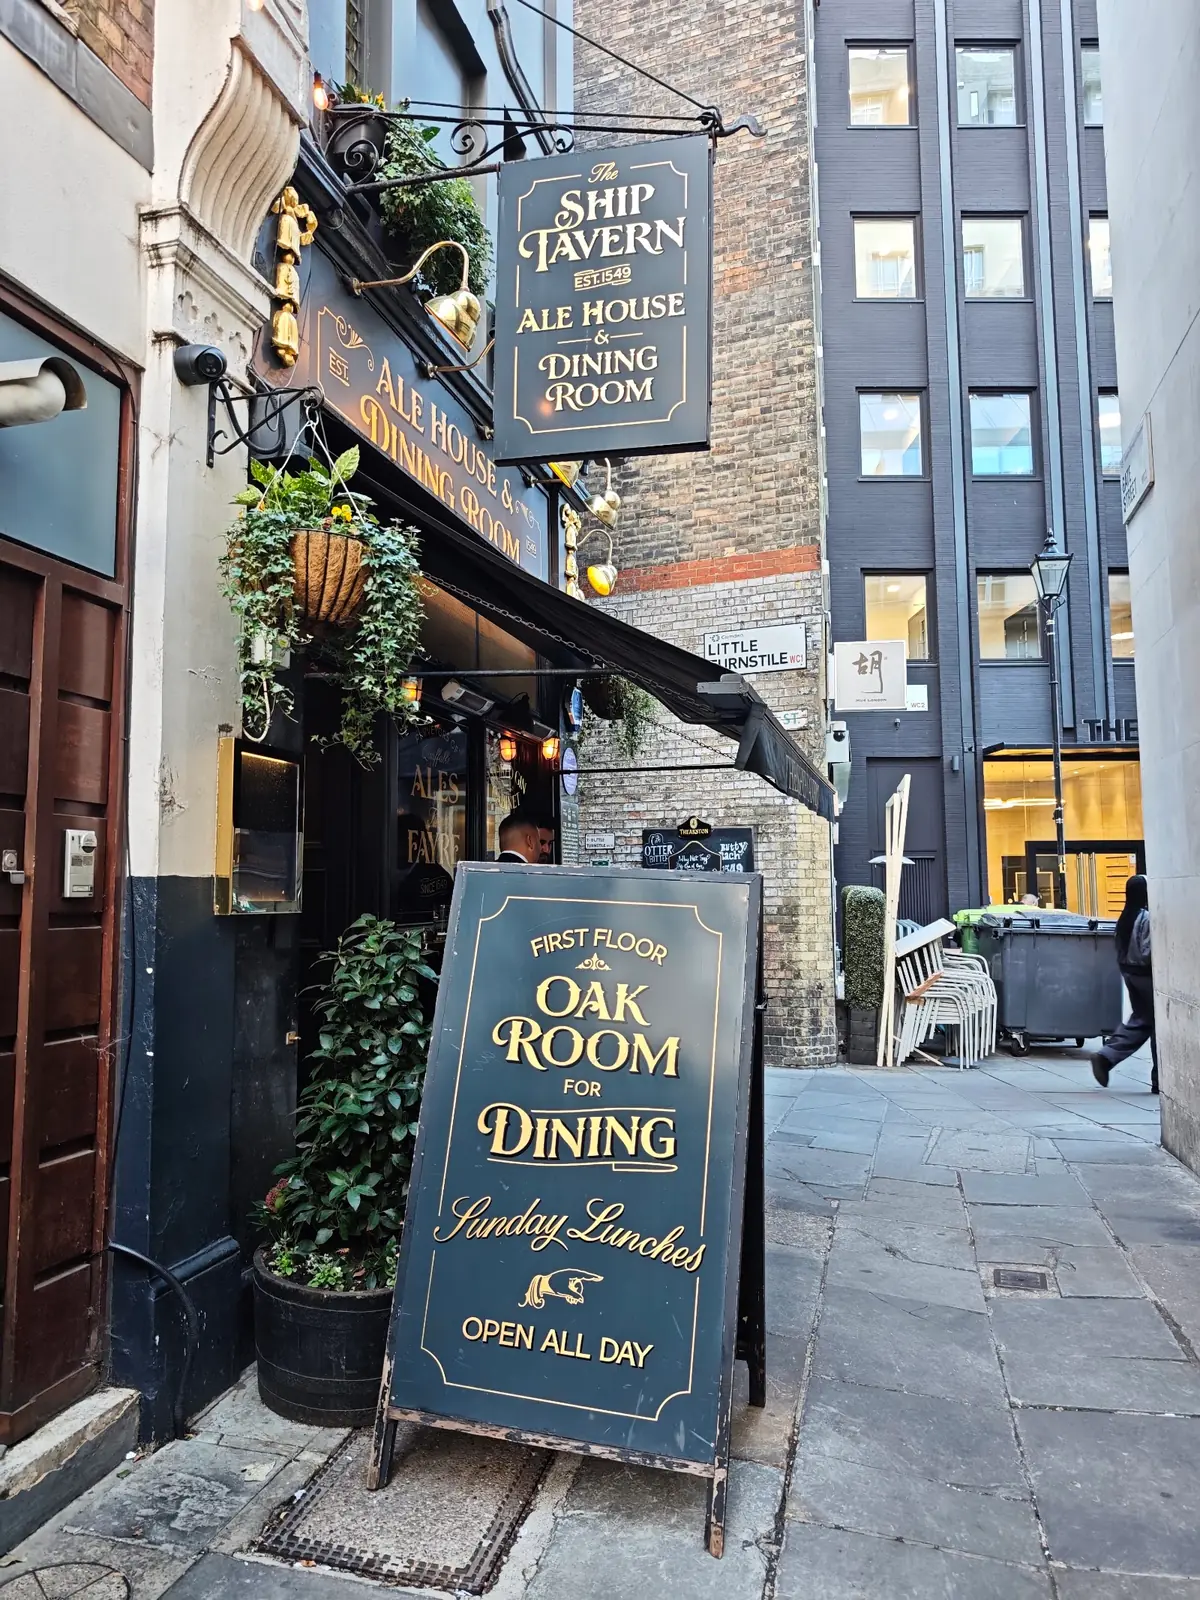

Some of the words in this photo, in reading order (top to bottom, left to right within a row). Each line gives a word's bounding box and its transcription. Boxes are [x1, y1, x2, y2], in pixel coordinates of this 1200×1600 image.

[588, 162, 618, 185] The
[555, 183, 656, 230] SHIP
[518, 216, 687, 273] TAVERN
[516, 306, 574, 334] ALE
[583, 292, 686, 326] HOUSE
[595, 330, 609, 345] &
[329, 352, 350, 381] EST.
[538, 345, 658, 380] DINING
[545, 377, 655, 411] ROOM
[375, 356, 425, 434] ALE
[431, 401, 498, 498] HOUSE
[501, 479, 514, 515] &
[360, 394, 455, 511] DINING
[460, 485, 521, 565] ROOM
[708, 639, 758, 656] LITTLE
[789, 654, 804, 664] WC1
[1082, 718, 1139, 742] THE
[410, 763, 460, 804] ALES
[407, 829, 461, 868] FAYRE
[644, 844, 673, 857] OTTER
[530, 928, 590, 958] FIRST
[593, 928, 669, 966] FLOOR
[536, 975, 652, 1027] OAK
[492, 1015, 682, 1078] ROOM
[563, 1079, 602, 1097] FOR
[477, 1102, 677, 1159] DINING
[433, 1196, 569, 1252] Sunday
[566, 1198, 707, 1272] Lunches
[461, 1316, 536, 1350] OPEN
[540, 1329, 592, 1359] ALL
[599, 1337, 654, 1369] DAY
